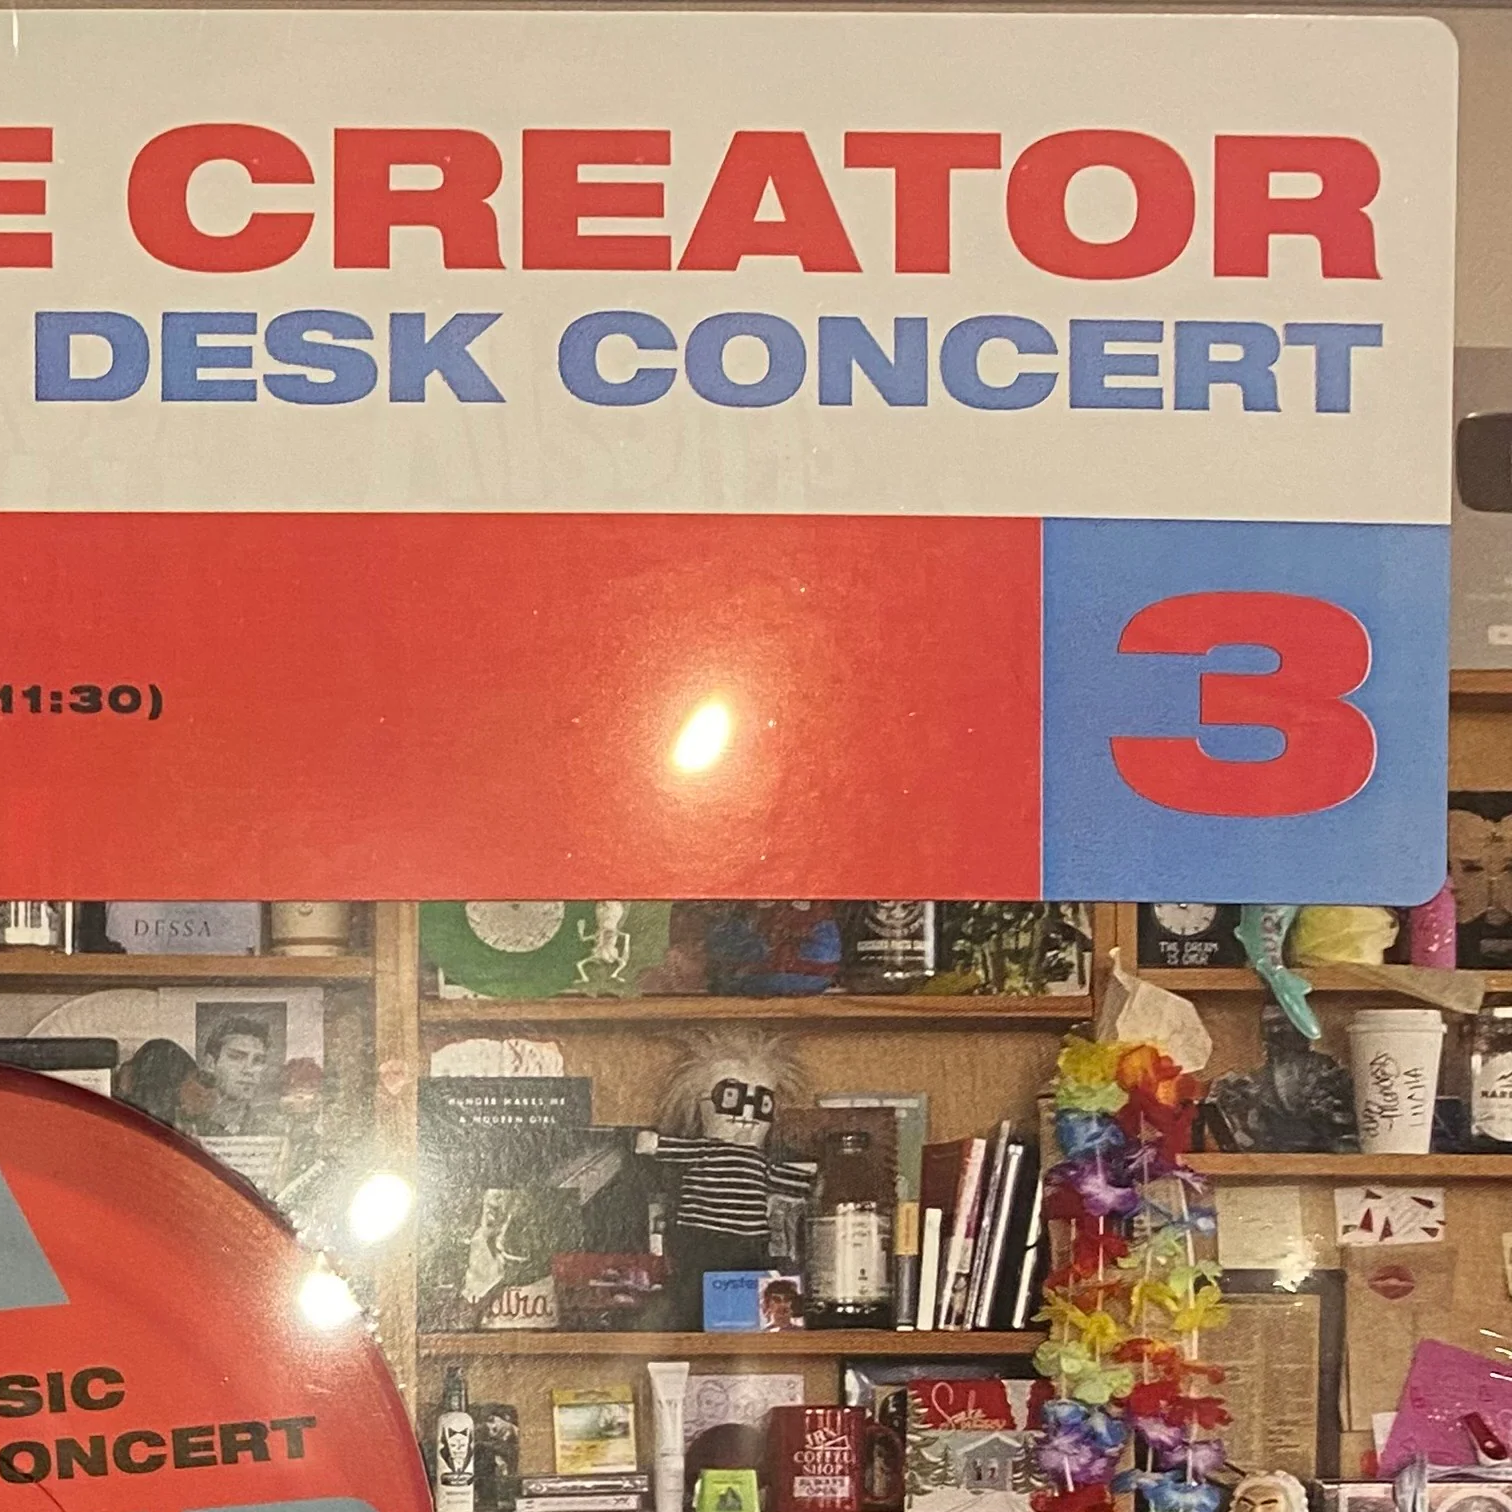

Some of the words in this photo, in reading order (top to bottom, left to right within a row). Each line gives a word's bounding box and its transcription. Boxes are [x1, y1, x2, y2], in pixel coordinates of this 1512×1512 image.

[126, 123, 1382, 282] CREATOR
[34, 309, 506, 405] DESK
[557, 310, 1383, 414] CONCERT
[1110, 591, 1379, 818] 3
[134, 919, 211, 937] DESSA
